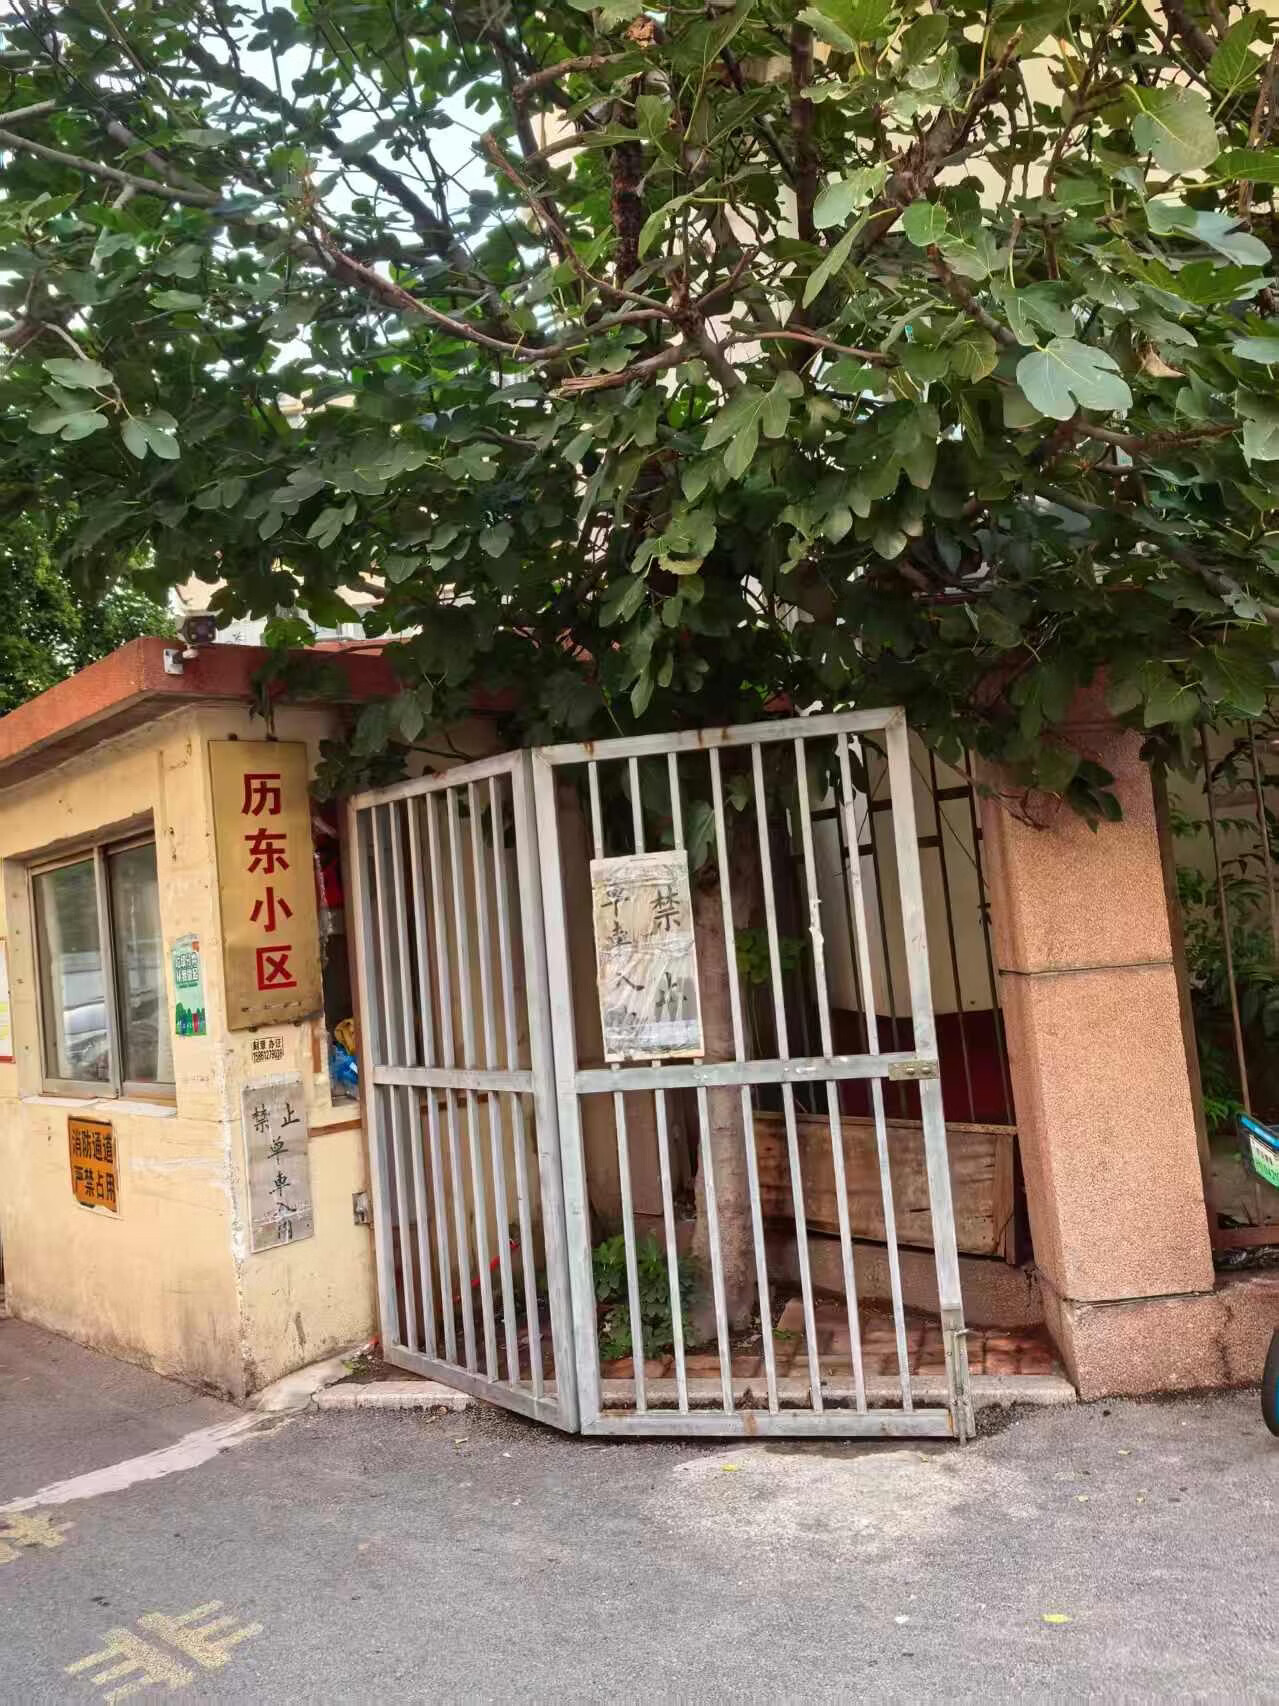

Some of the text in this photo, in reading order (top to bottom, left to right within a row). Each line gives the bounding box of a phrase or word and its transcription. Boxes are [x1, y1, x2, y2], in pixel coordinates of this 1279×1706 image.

[241, 773, 297, 991] 历东小区
[251, 1102, 301, 1134] 禁止
[72, 1129, 114, 1164] 消防通道
[74, 1165, 117, 1204] 严禁占用
